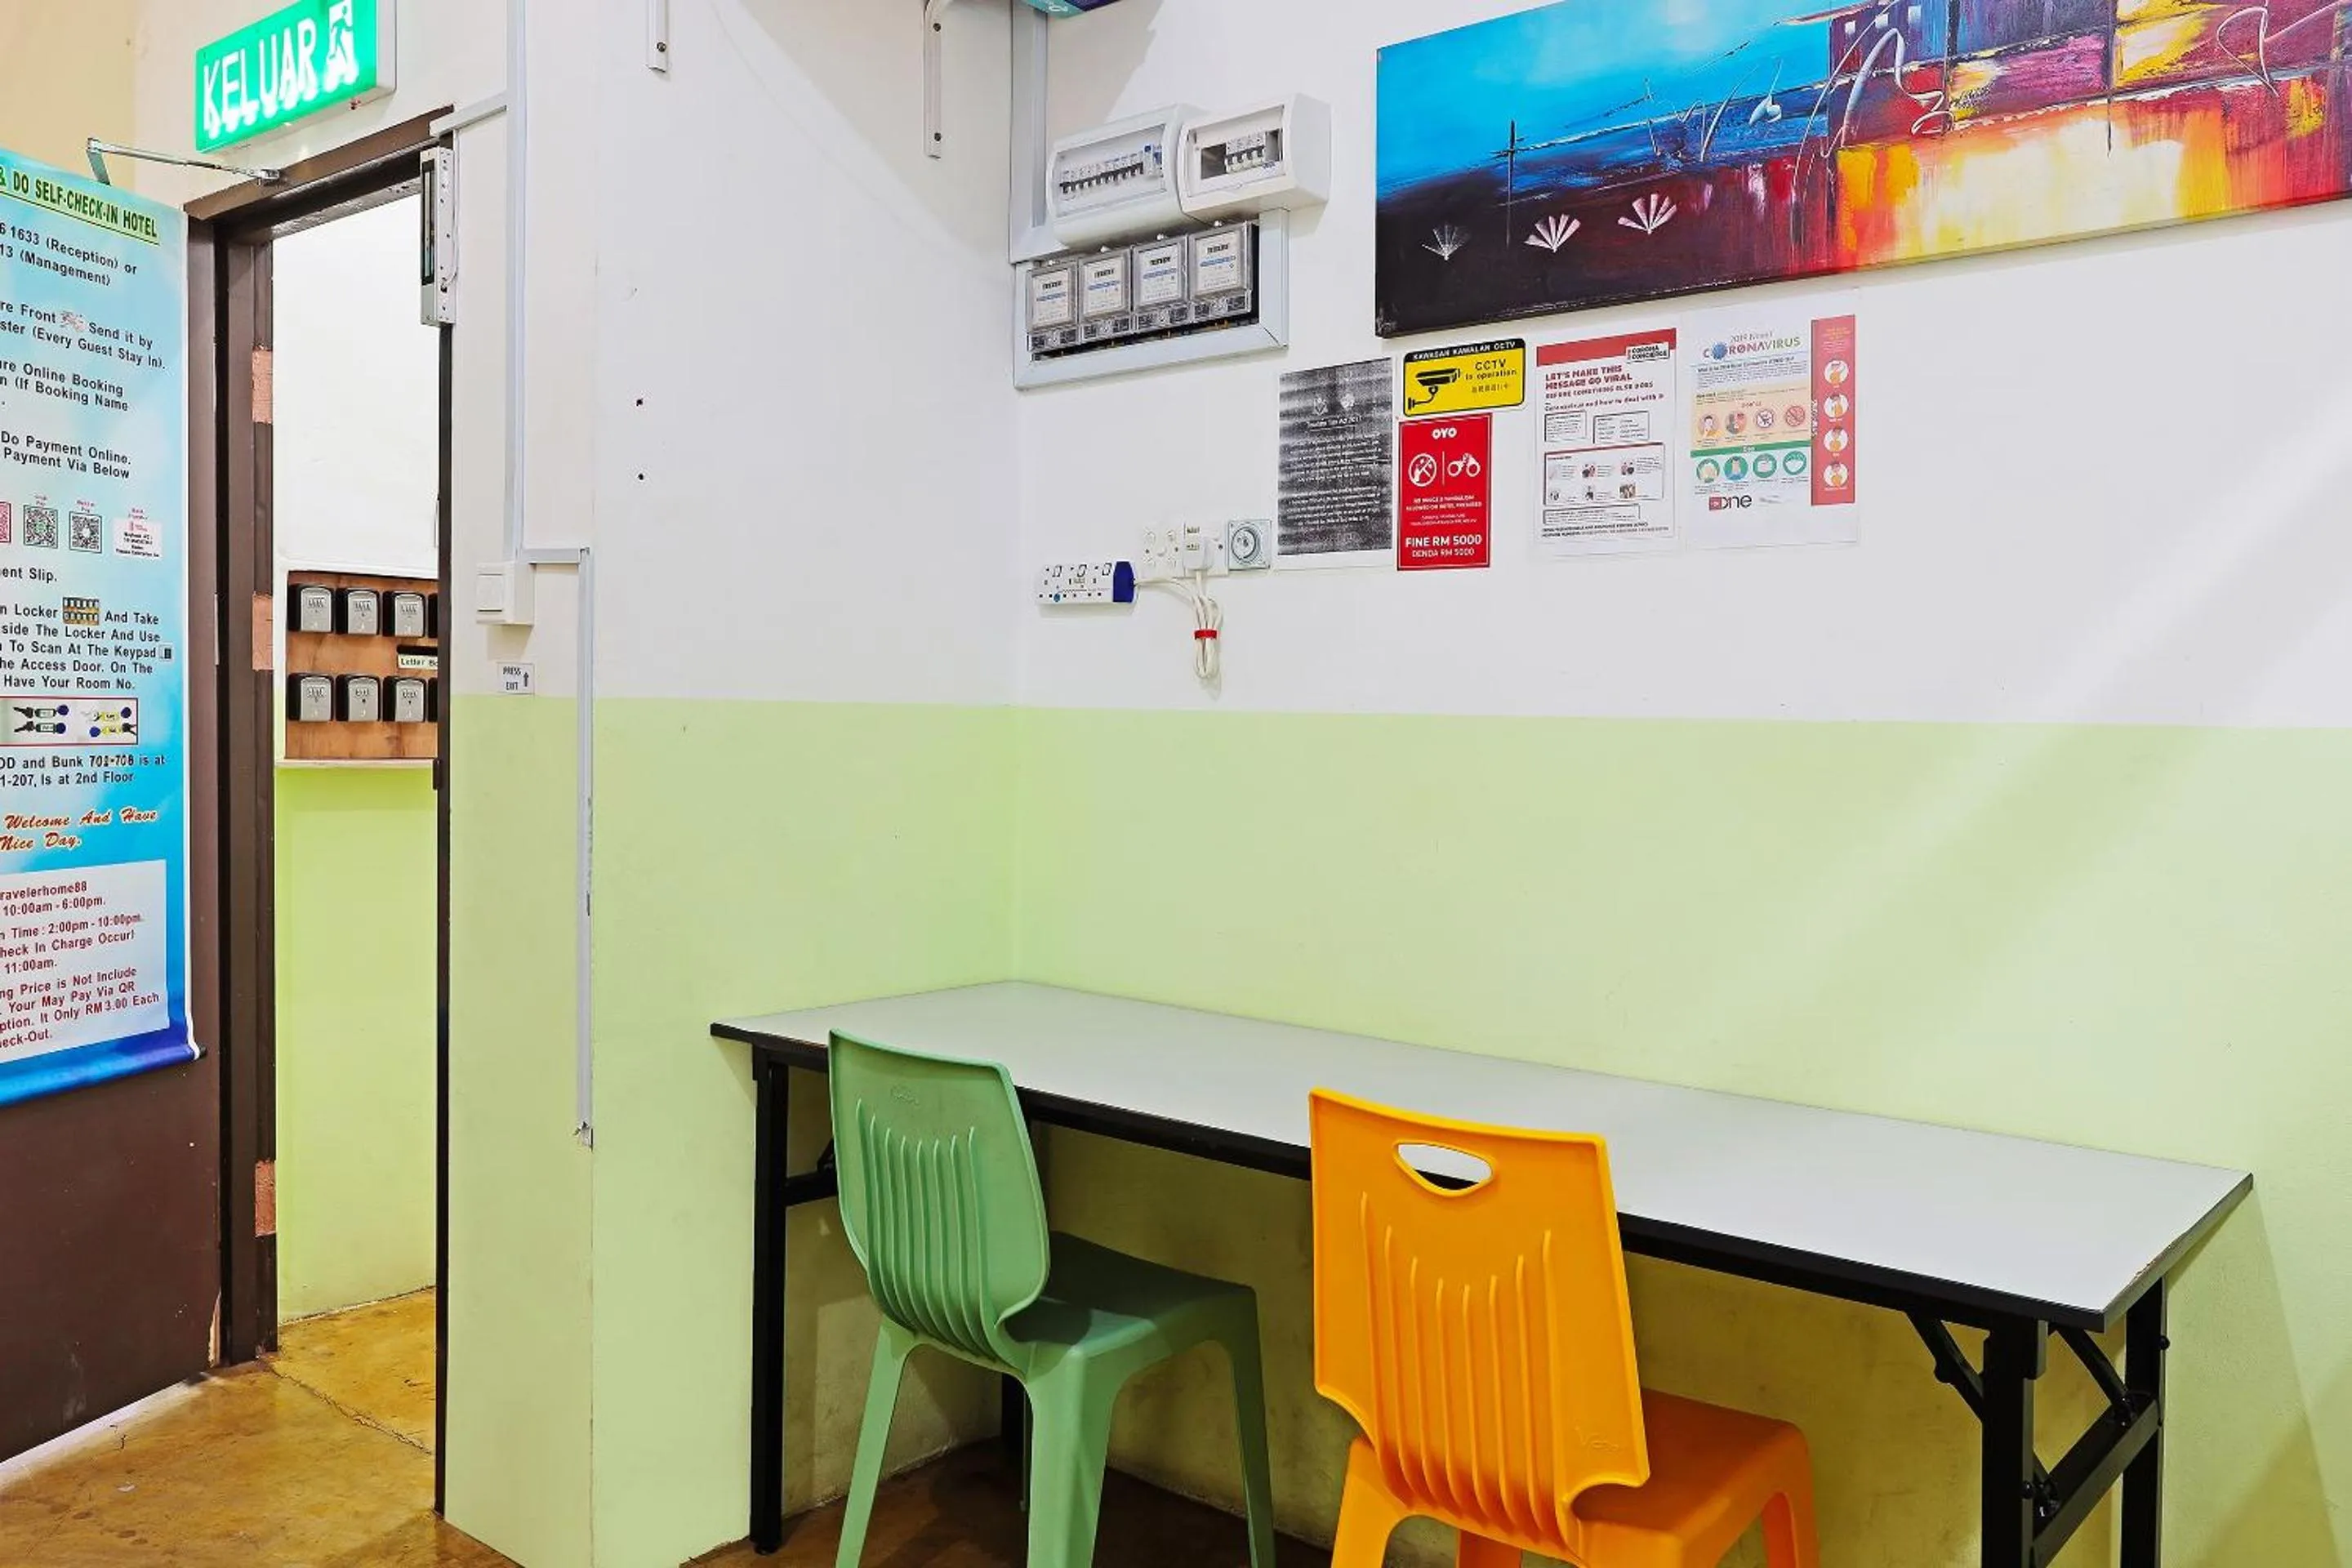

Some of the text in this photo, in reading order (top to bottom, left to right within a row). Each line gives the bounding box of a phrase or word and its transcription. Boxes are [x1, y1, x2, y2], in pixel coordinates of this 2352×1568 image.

[203, 17, 318, 139] KELUAR
[13, 170, 29, 194] DO
[35, 179, 118, 225] SELF-CHECK-IN
[123, 210, 157, 238] HOTEL
[11, 225, 40, 246] 1633
[47, 237, 118, 269] (Reception)
[124, 264, 137, 275] or
[20, 250, 111, 286] (Management)
[20, 303, 56, 323] Front
[89, 322, 120, 340] Send
[124, 331, 135, 343] it
[139, 336, 154, 350] by
[32, 325, 72, 348] (Every
[78, 337, 113, 357] Guest
[118, 347, 142, 367] Stay
[1475, 359, 1506, 371] CCTV
[1572, 368, 1598, 378] MAKE
[1601, 365, 1622, 374] THIS
[23, 363, 66, 384] Online
[73, 374, 123, 398] Booking
[1545, 373, 1633, 390] MESSAGE GO VIRAL
[15, 376, 29, 390] (If
[36, 381, 89, 405] Booking
[96, 394, 128, 412] Name
[1432, 427, 1457, 439] OYO
[1, 431, 131, 465] Do Payment Online.
[4, 448, 130, 479] Payment Via Below
[1405, 534, 1482, 548] FINE RM 5000
[29, 567, 58, 583] Slip.
[15, 604, 58, 618] Locker
[105, 612, 128, 624] And
[134, 612, 159, 626] Take
[2, 623, 161, 643] side The Locker And Use
[9, 639, 24, 653] To
[31, 641, 62, 655] Scan
[68, 642, 81, 655] At
[87, 644, 109, 657] The
[114, 645, 156, 660] Keypad
[21, 658, 66, 671] Access
[74, 660, 105, 672] Door.
[110, 661, 127, 674] On
[133, 662, 153, 675] The
[4, 675, 135, 690] Have Your Room No.
[23, 756, 46, 769] and
[52, 755, 82, 768] Bunk
[139, 755, 150, 766] is
[154, 754, 165, 766] at
[42, 773, 51, 786] Is
[59, 774, 70, 786] at
[76, 773, 97, 785] 2nd
[104, 771, 134, 784] Floor
[5, 807, 158, 830] Welcome And Have
[0, 832, 81, 851] Nice Day.
[3, 902, 52, 916] 10:00am
[35, 942, 46, 954] In
[51, 935, 93, 952] Charge
[98, 929, 135, 944] Occur!
[20, 982, 51, 996] Price
[57, 978, 67, 989] is
[74, 973, 92, 987] Not
[97, 967, 137, 982] Include
[9, 981, 135, 1013] Your May Pay Via QR
[54, 1007, 79, 1022] Only
[133, 993, 159, 1007] Each
